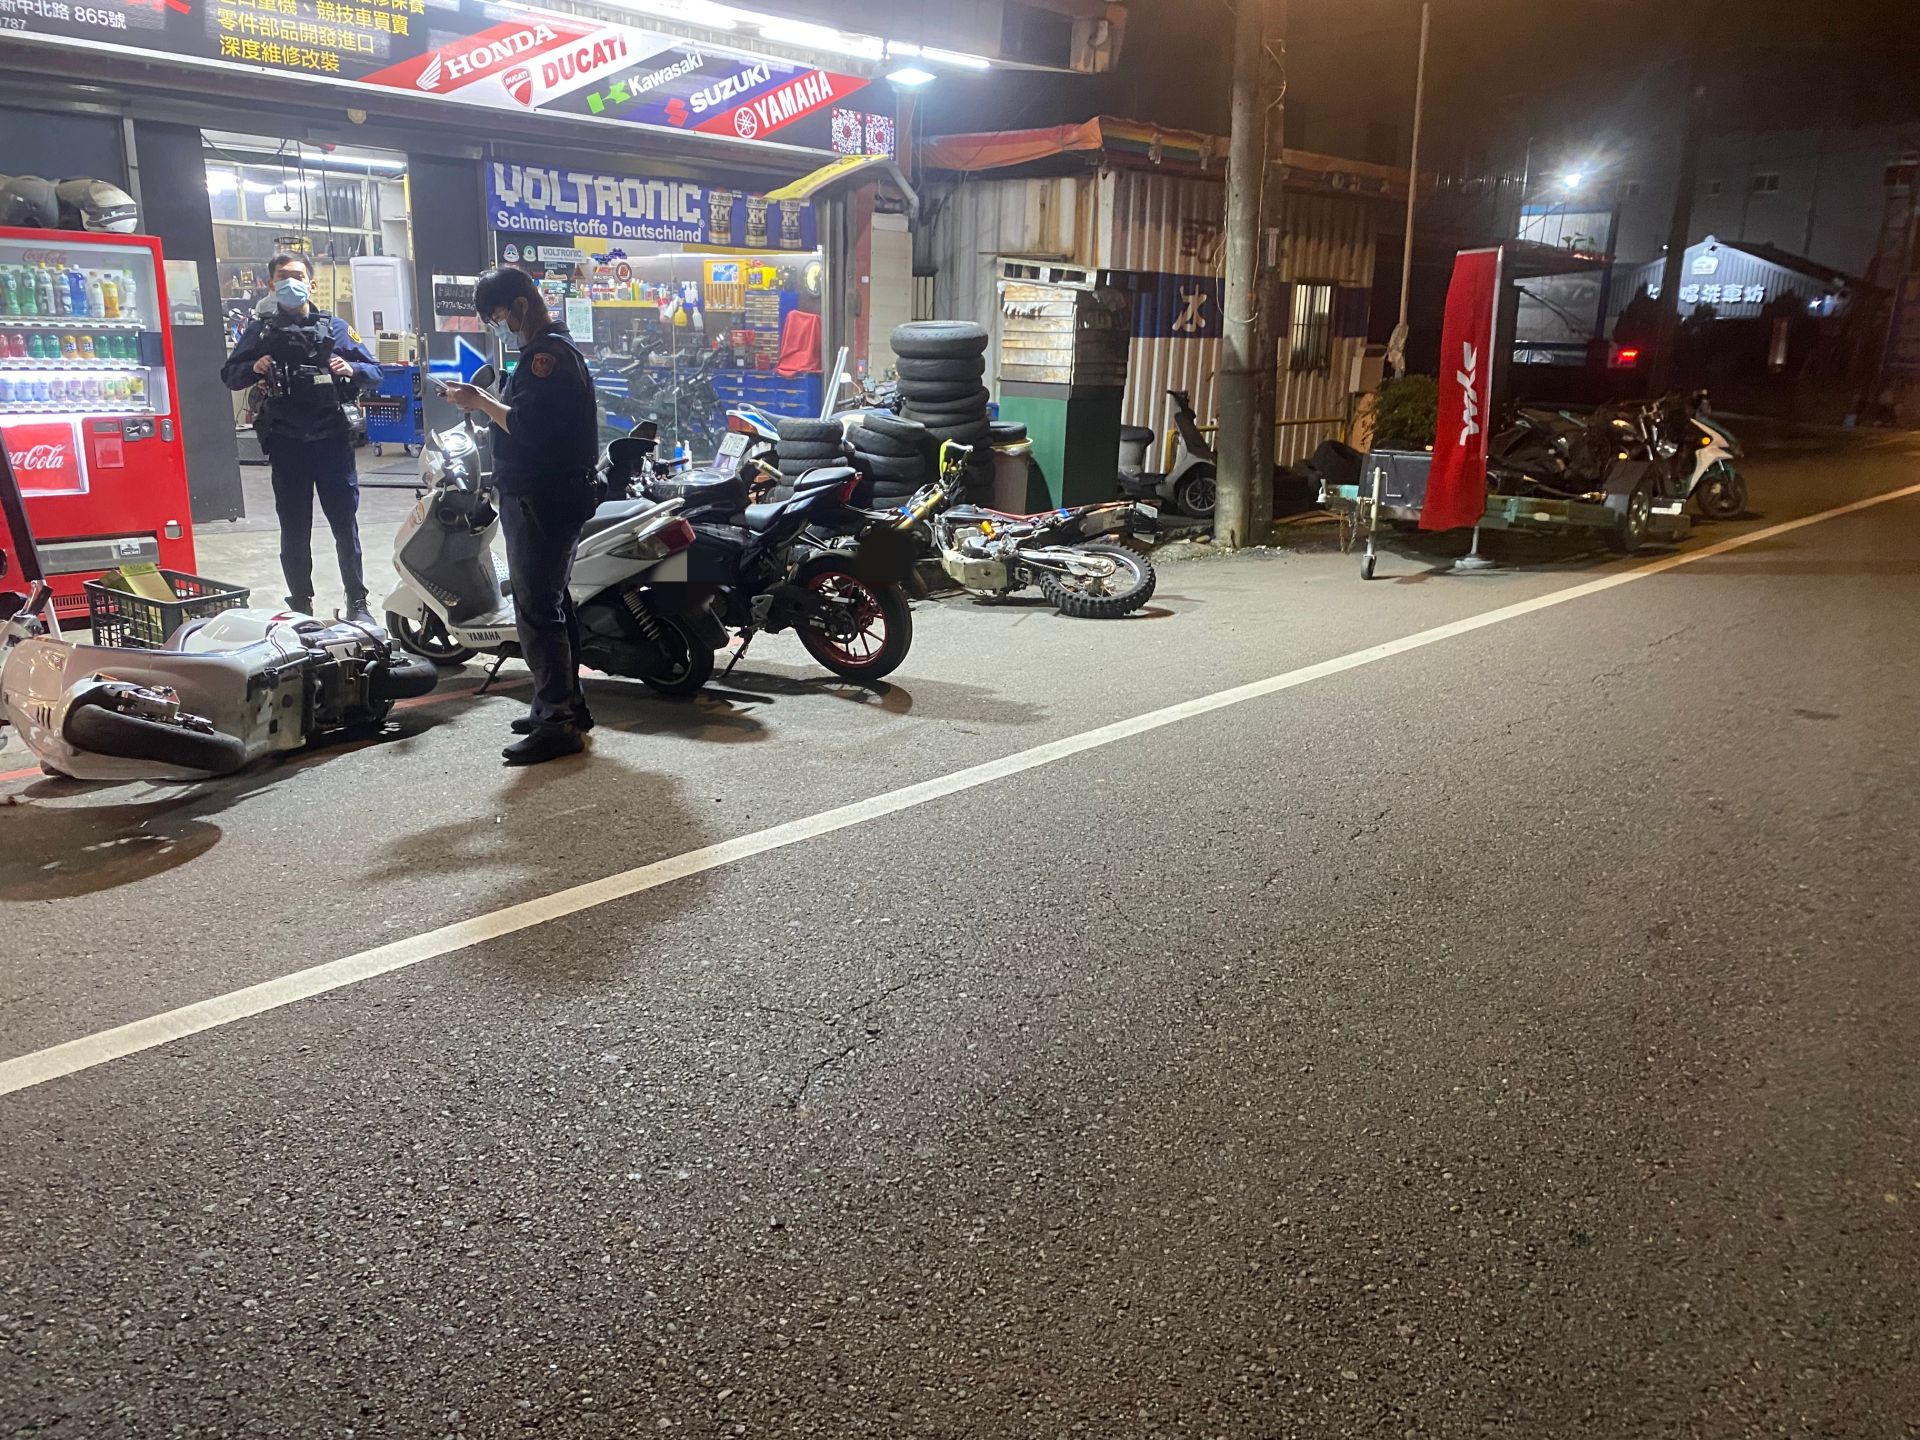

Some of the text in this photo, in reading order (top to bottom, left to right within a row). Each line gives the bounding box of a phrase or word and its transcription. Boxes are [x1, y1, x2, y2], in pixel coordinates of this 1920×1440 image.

[74, 6, 127, 29] 865號
[217, 8, 375, 54] 零件部品開發進口
[219, 34, 340, 73] 深度維修改裝
[443, 24, 558, 80] HONDA
[541, 33, 628, 88] DUCATI
[504, 70, 529, 85] DUCATI
[628, 53, 704, 97] Kawasaki
[689, 62, 772, 114] SUZUKI
[756, 71, 833, 128] YAMAHA
[493, 162, 702, 224] VOLTRONIC
[496, 211, 702, 243] Schmierstoffe Deutschland
[467, 631, 501, 641] YAMAHA
